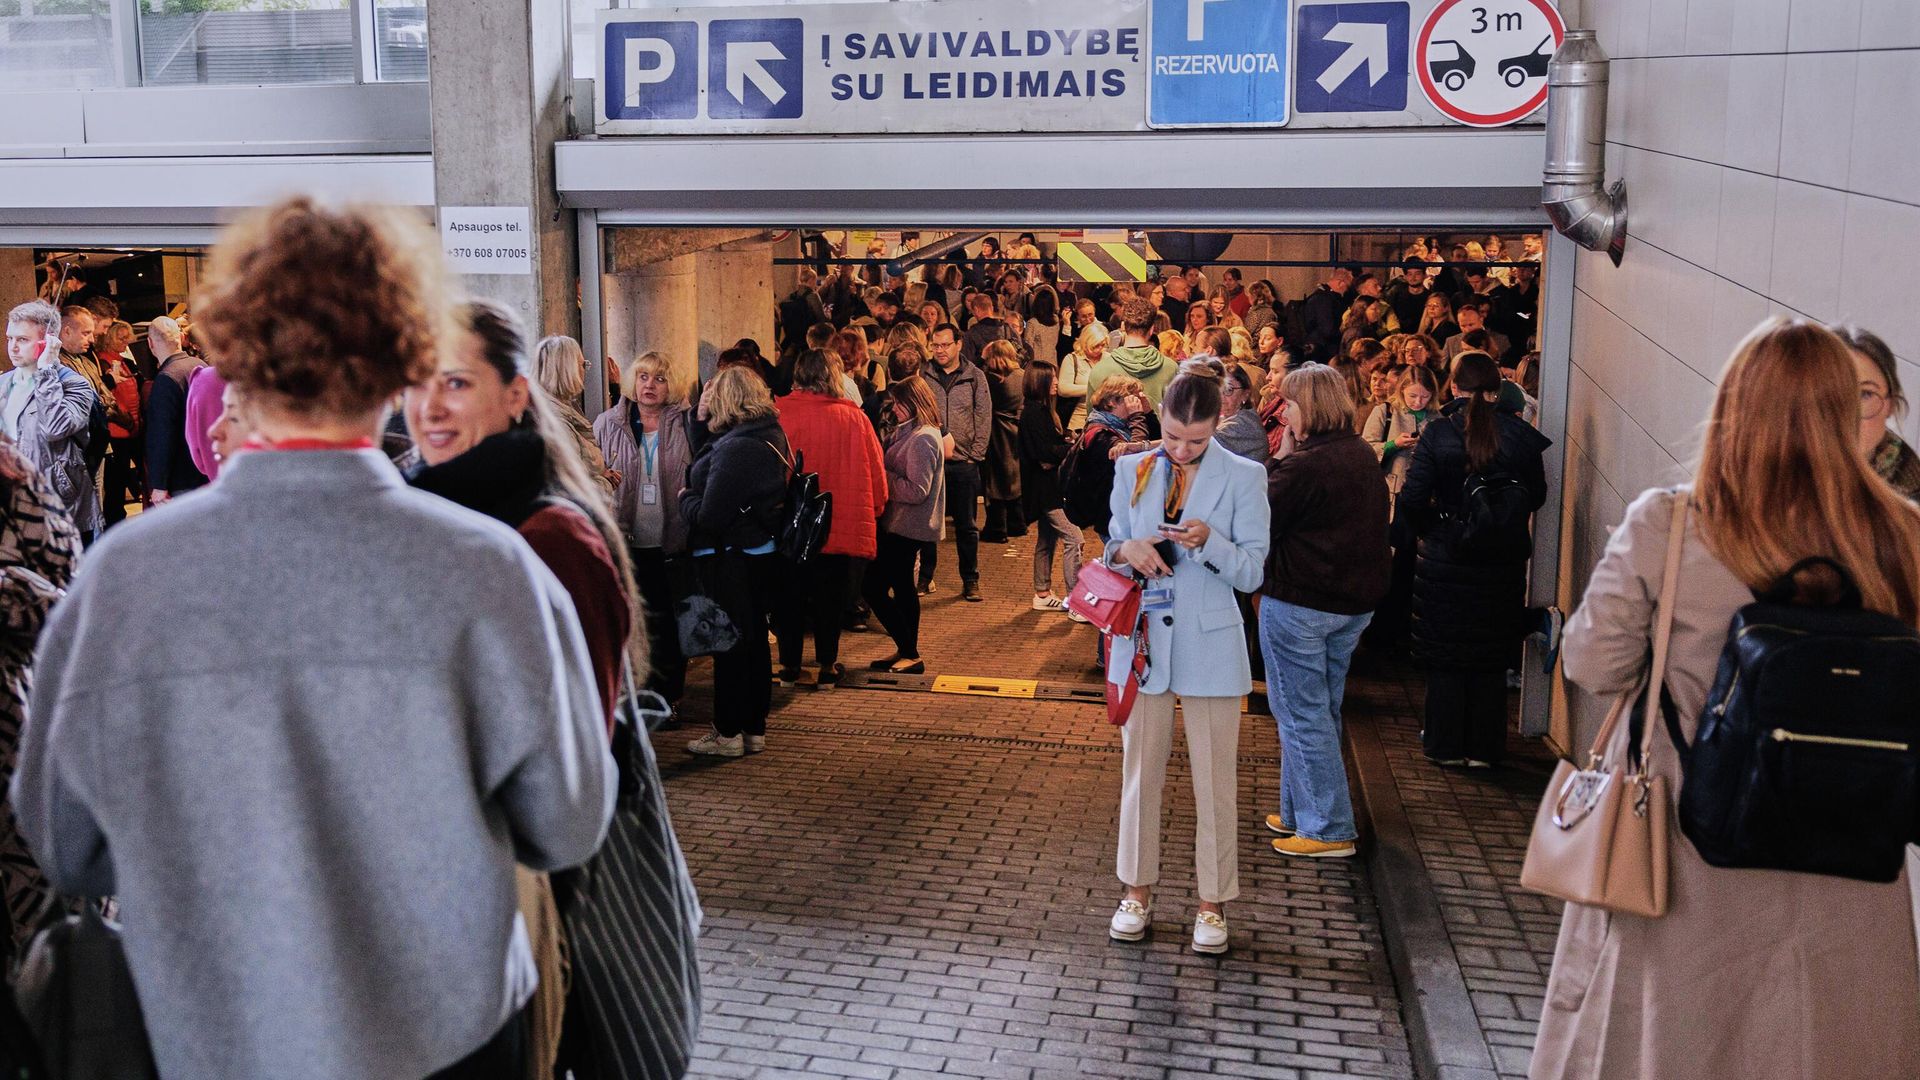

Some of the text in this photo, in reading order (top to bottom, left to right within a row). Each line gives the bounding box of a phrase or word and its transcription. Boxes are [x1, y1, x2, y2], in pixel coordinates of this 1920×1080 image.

[1471, 7, 1522, 34] 3 m
[844, 28, 1139, 63] SAVIVALDYBĘ
[625, 38, 676, 108] P
[1155, 53, 1279, 75] REZERVUOTA
[831, 68, 1126, 101] SU LEIDIMAIS
[449, 222, 522, 234] Apsaugos tel.
[447, 248, 527, 258] +370 608 07005
